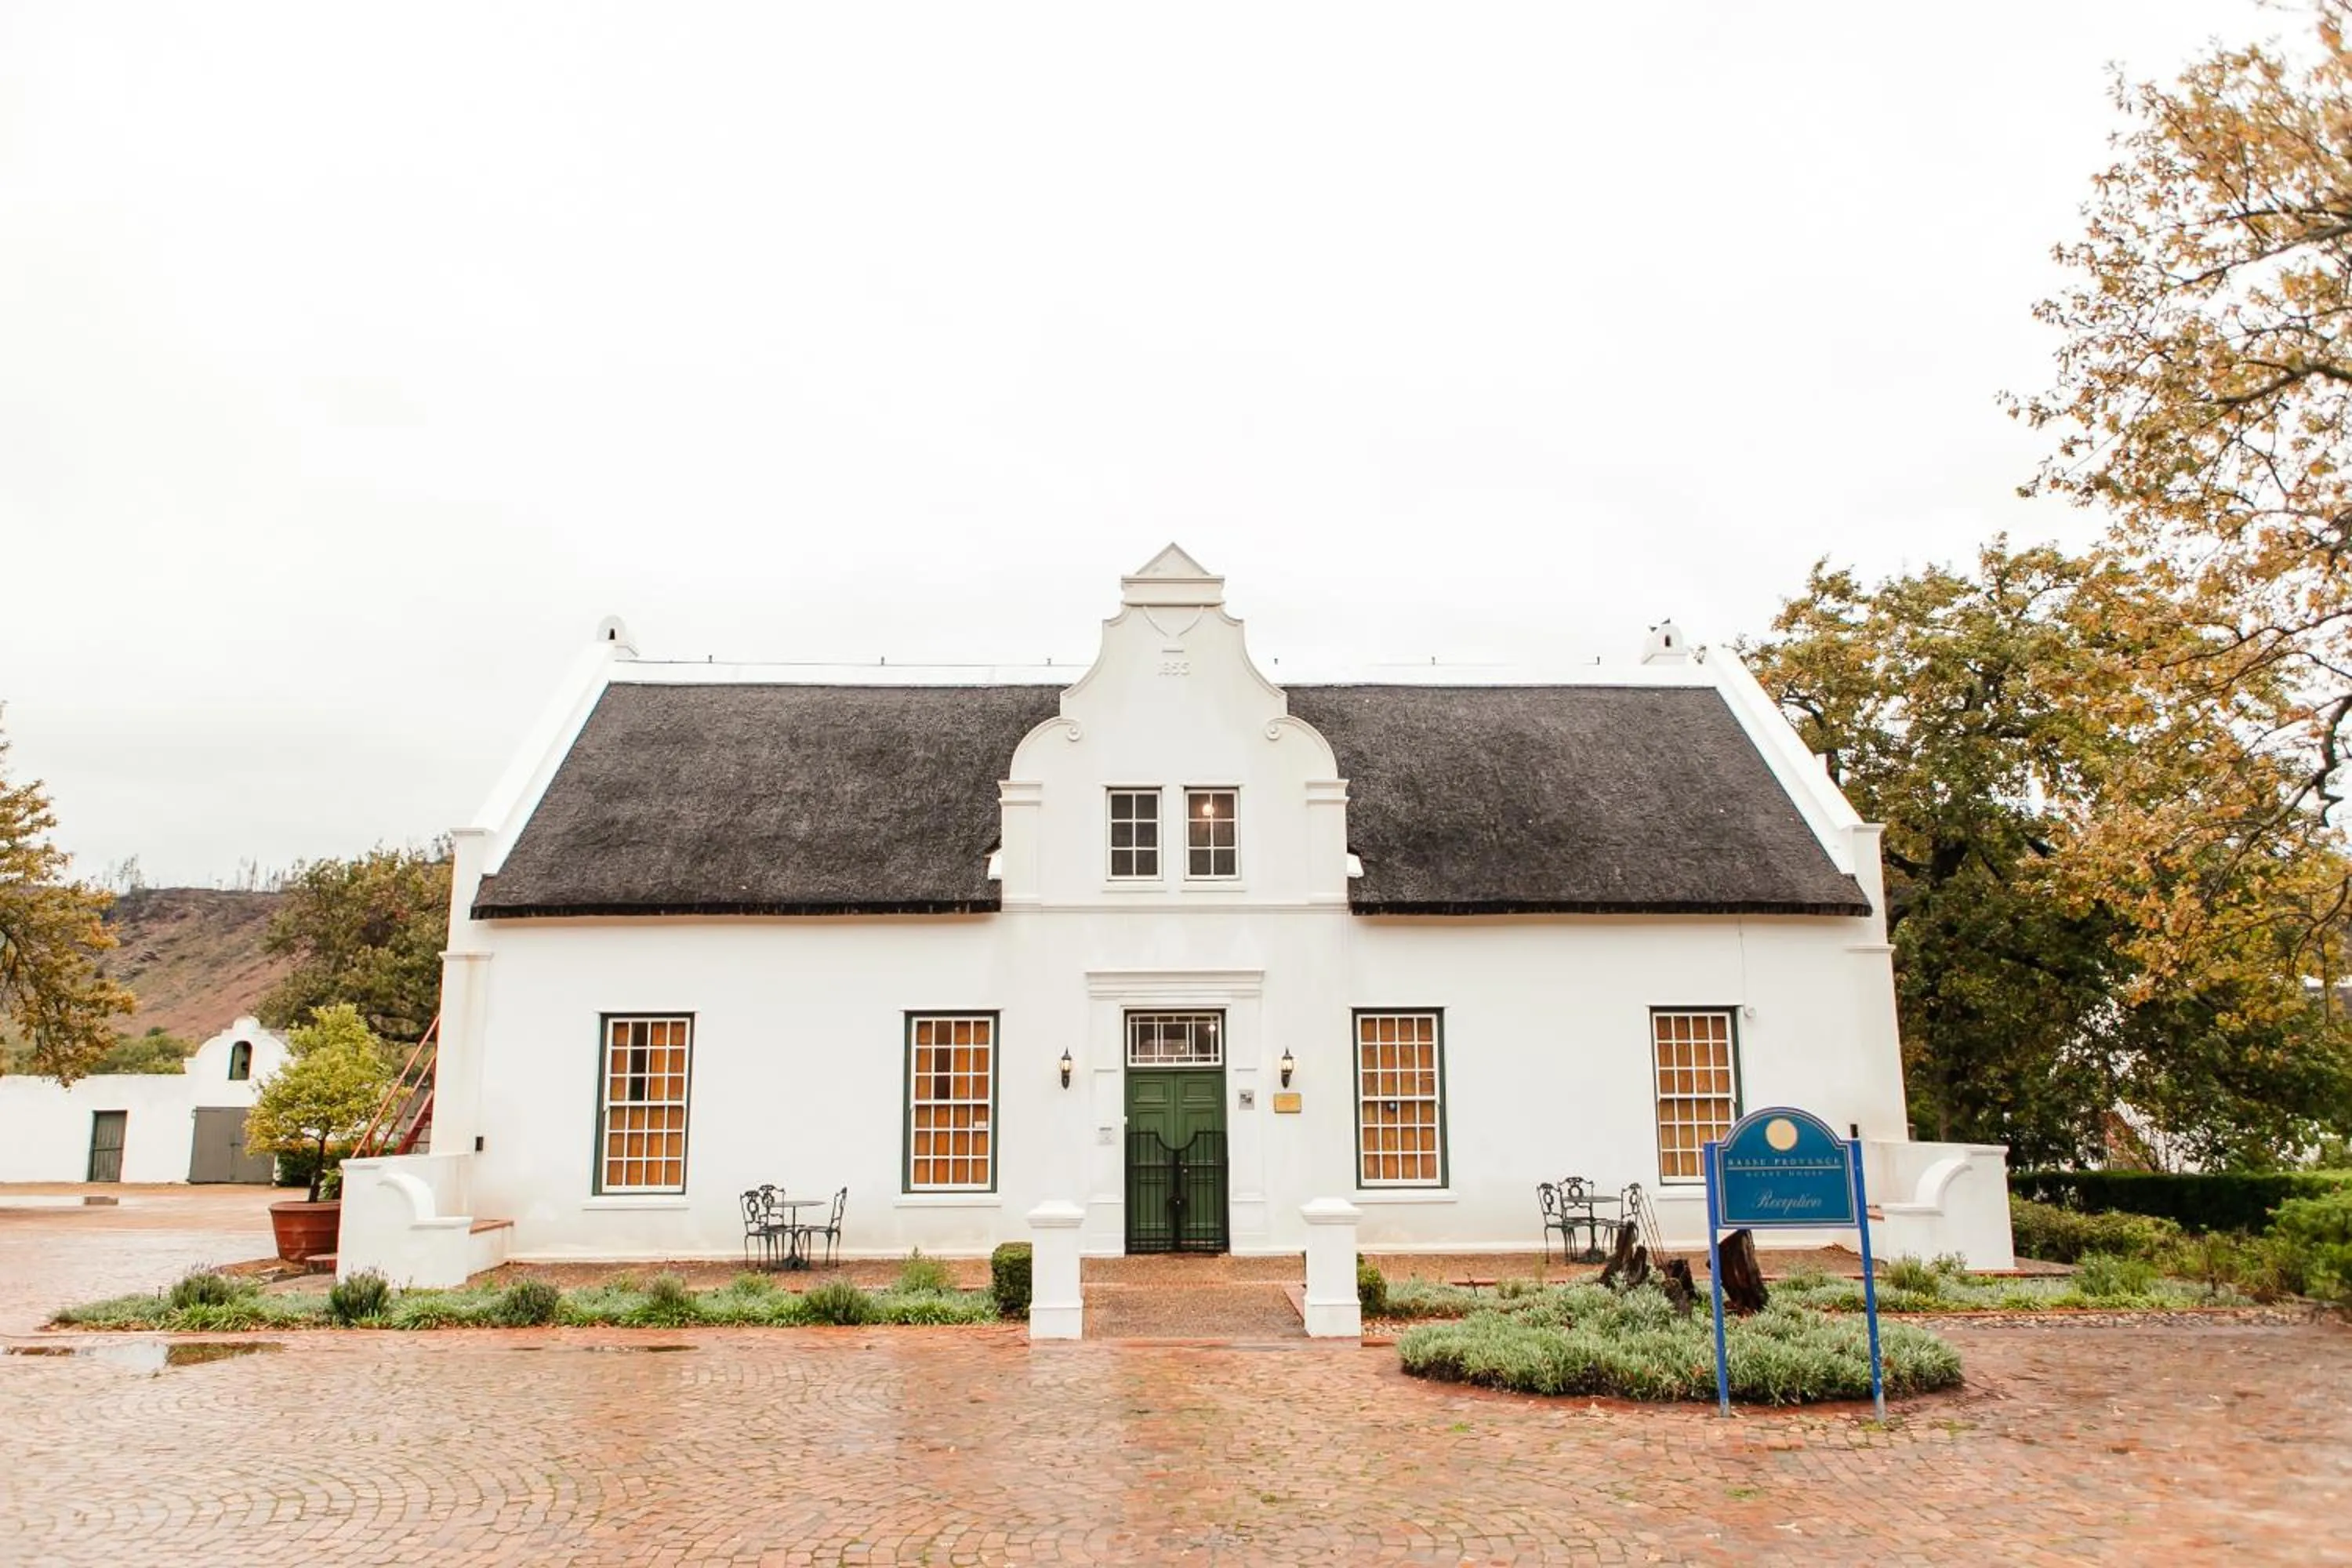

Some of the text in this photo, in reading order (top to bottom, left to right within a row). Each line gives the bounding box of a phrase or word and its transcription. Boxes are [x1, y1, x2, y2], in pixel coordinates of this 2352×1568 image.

[1157, 662, 1191, 676] 1855
[1774, 1156, 1839, 1166] PROVENCE
[1751, 1189, 1823, 1215] Reception
